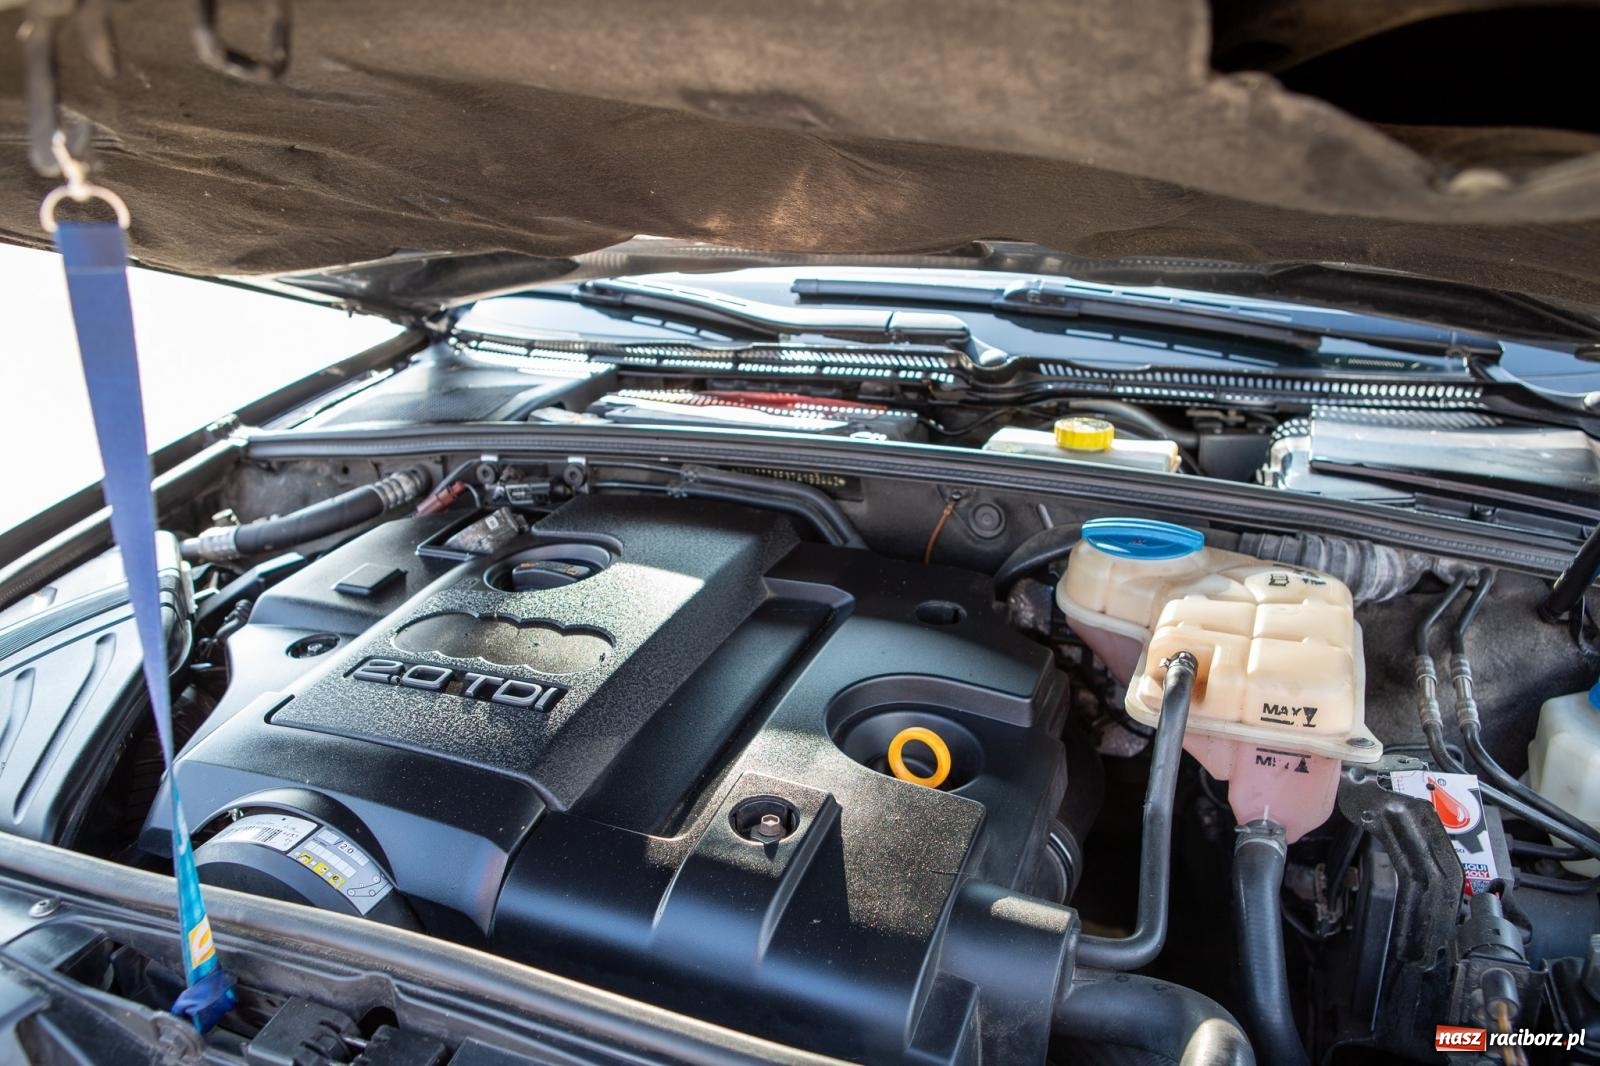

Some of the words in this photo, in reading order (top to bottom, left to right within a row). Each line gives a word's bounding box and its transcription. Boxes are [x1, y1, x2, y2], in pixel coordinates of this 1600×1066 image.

[352, 658, 453, 691] 2.0
[464, 671, 558, 713] TDI
[1255, 754, 1290, 770] MI
[1463, 863, 1488, 872] IQUI
